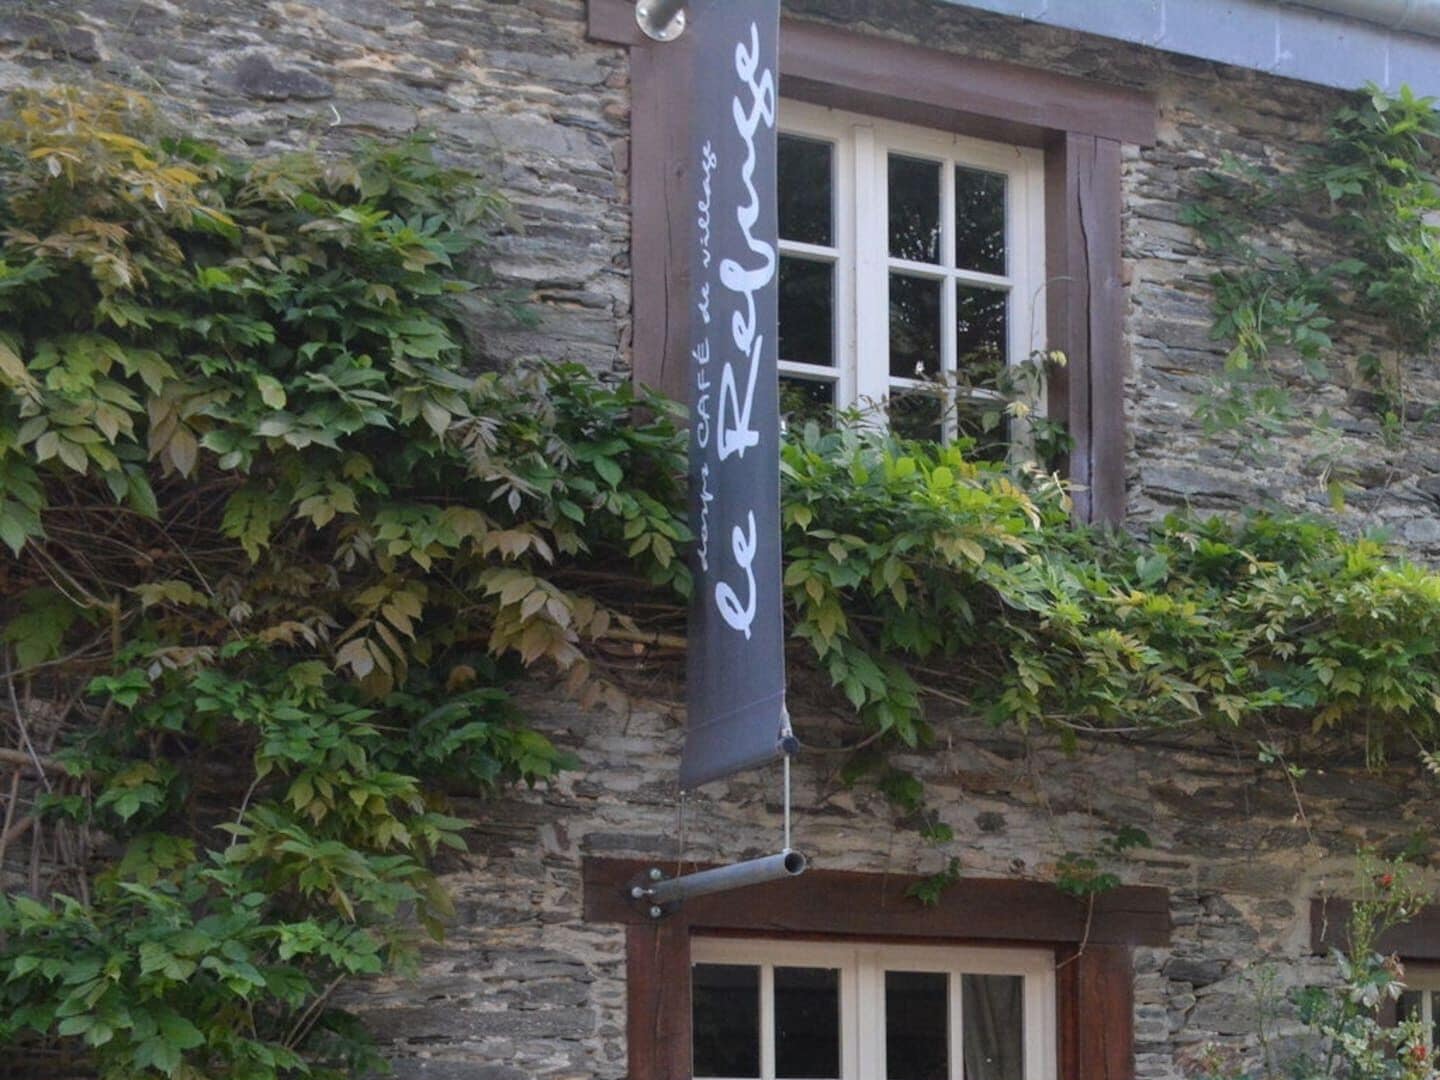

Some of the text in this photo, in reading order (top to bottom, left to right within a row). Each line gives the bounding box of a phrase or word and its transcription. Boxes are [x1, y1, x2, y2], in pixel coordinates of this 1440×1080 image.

[692, 139, 717, 571] dorps CAFÉ de village
[715, 21, 776, 640] le Refuge
